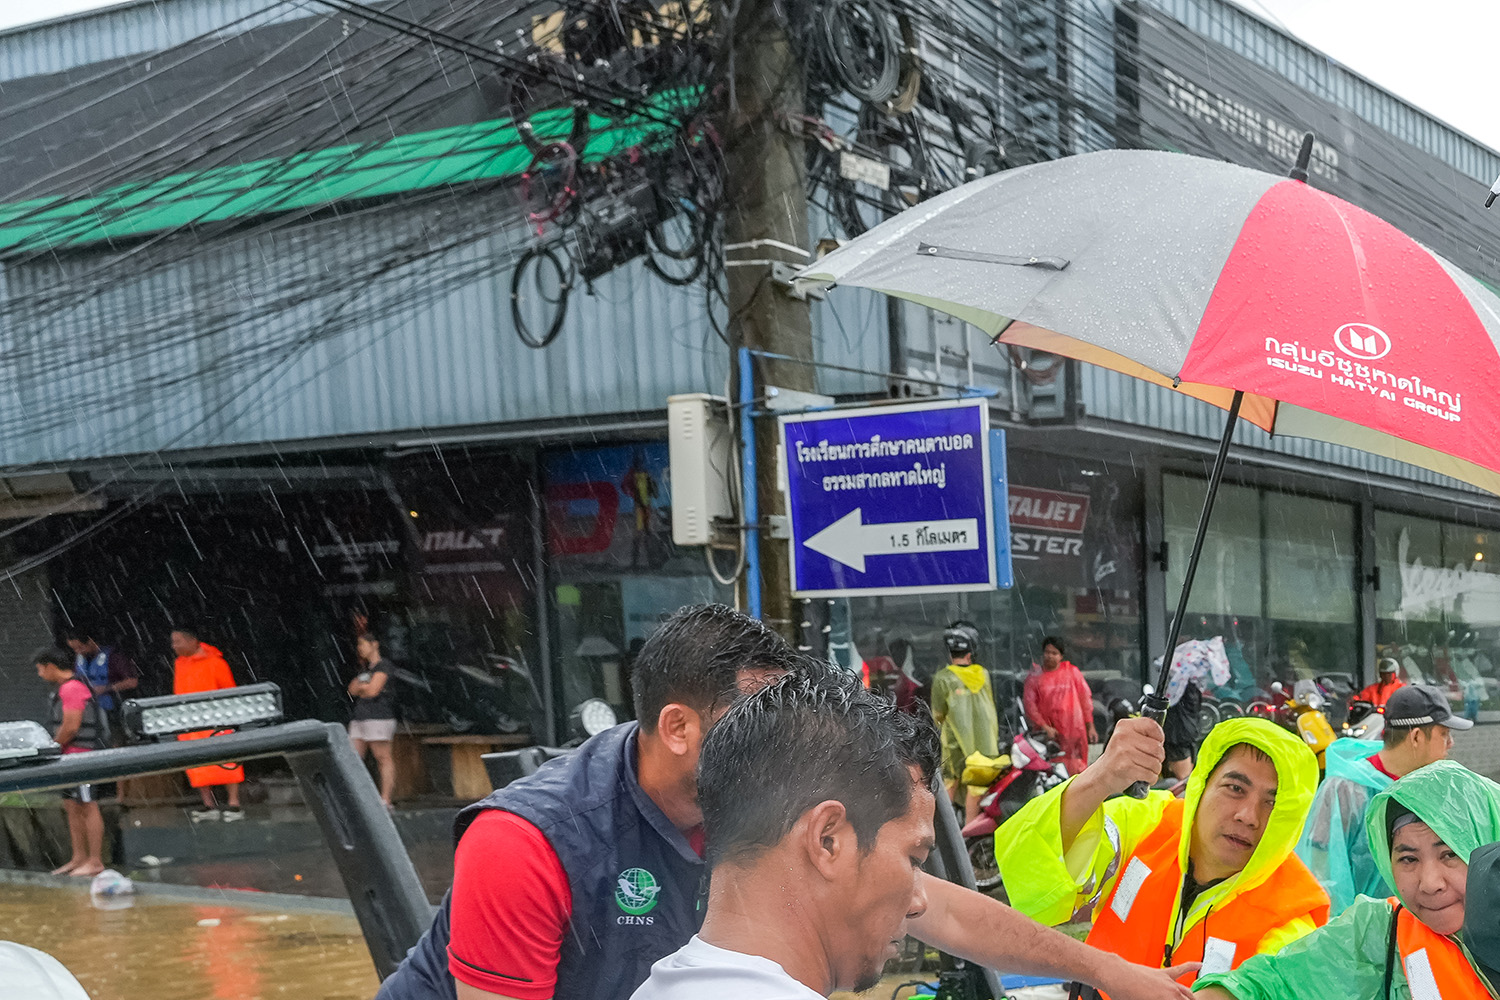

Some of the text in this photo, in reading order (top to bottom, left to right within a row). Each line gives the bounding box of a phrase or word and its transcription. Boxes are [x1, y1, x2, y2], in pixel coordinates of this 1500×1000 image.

[1266, 118, 1339, 183] MOOR
[1264, 336, 1462, 414] กลุ่มอีซูซุหาดใหญ่
[1266, 356, 1461, 423] ISUZU HATYAI GROUP
[795, 433, 974, 463] โรงเรียนการศึกษาคนตาบอด
[822, 461, 947, 491] ธรรมสากลหาดใหญ่
[1008, 495, 1082, 523] TALJET
[890, 526, 968, 548] 1.5 กิโลเมตร
[1010, 532, 1084, 556] STER
[616, 915, 654, 926] CHNS
